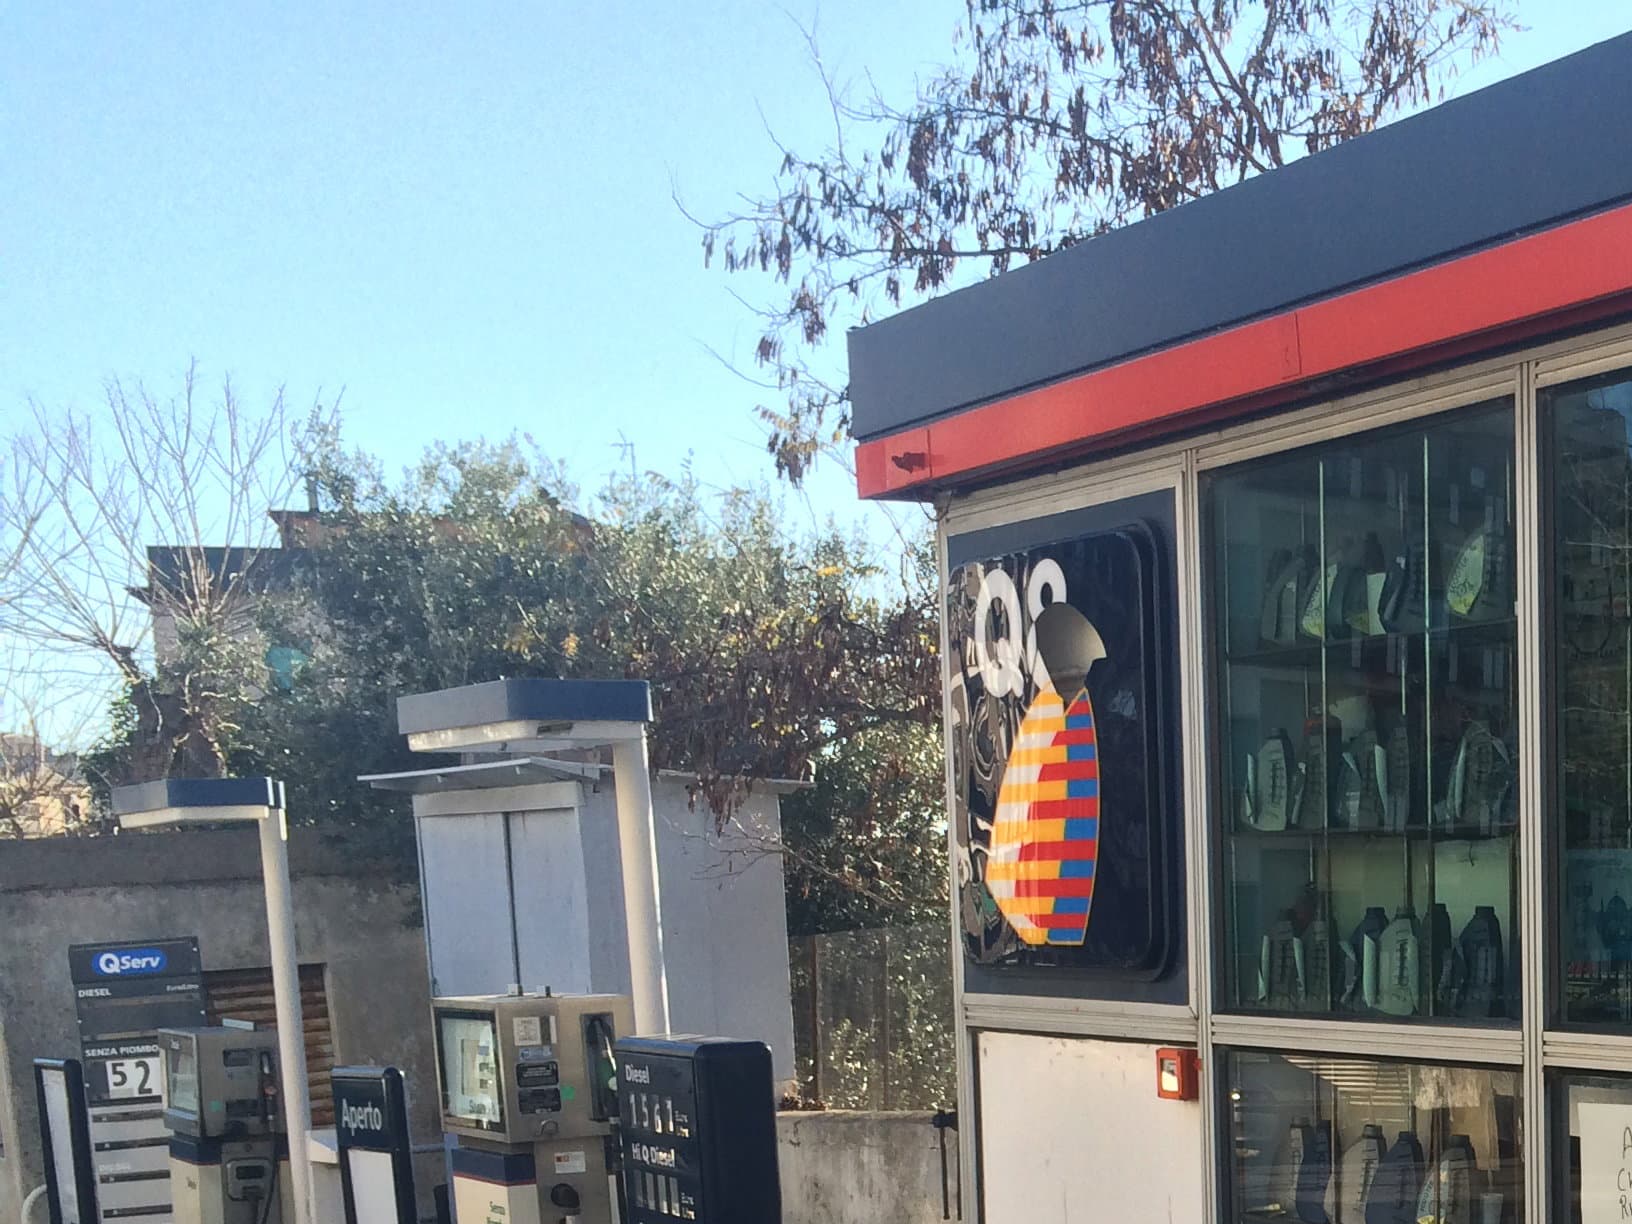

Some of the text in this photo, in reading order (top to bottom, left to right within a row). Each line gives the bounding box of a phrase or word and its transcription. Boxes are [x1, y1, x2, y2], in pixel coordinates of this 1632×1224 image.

[99, 952, 160, 974] QServ
[78, 988, 112, 998] DIESEL
[84, 1047, 118, 1057] SENZA
[120, 1044, 160, 1055] PIOMBO
[625, 1064, 650, 1084] Diesel
[342, 1098, 382, 1137] Aperto
[641, 1145, 650, 1166] Q
[650, 1146, 676, 1168] Diesel
